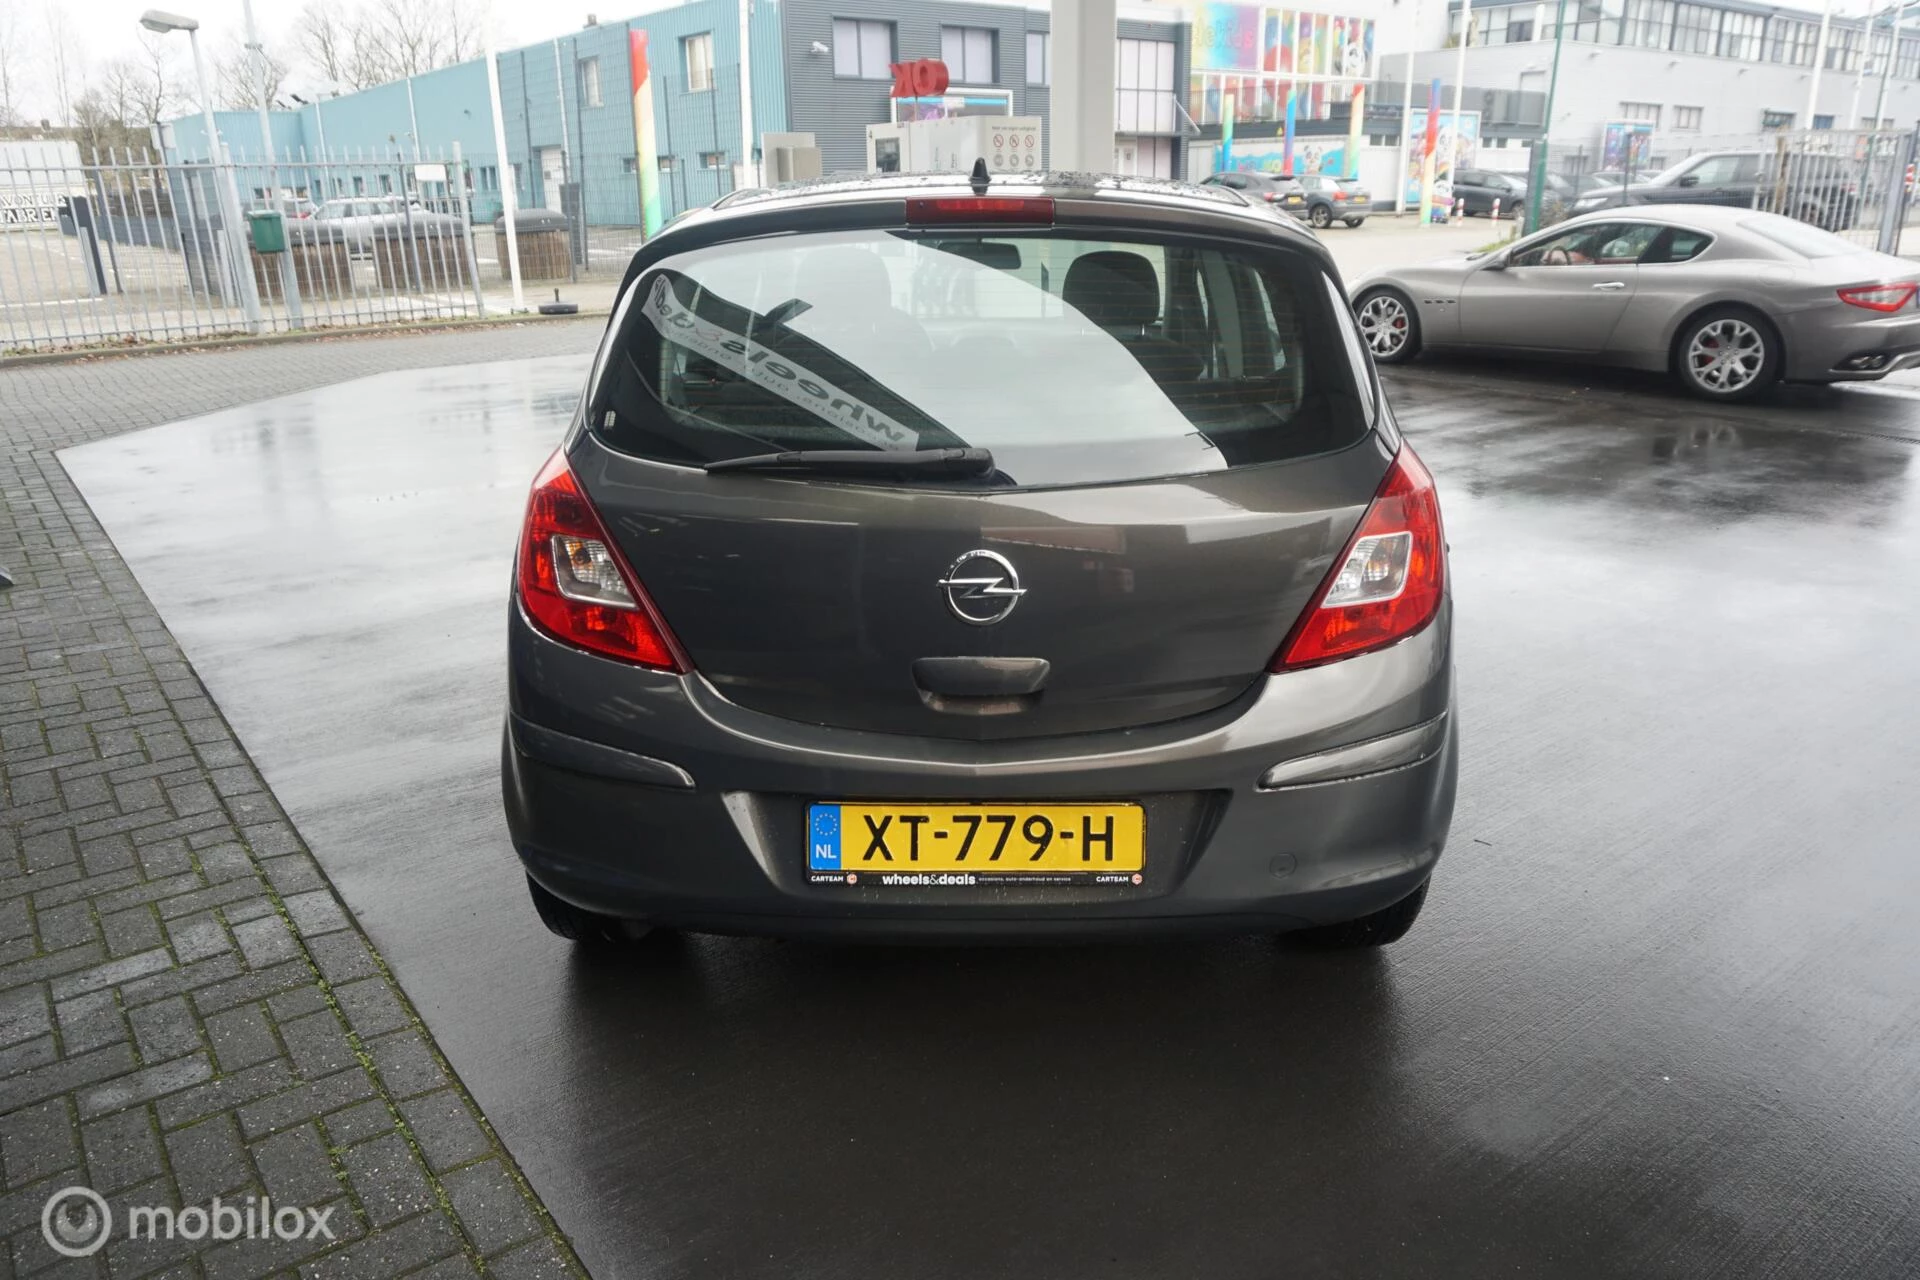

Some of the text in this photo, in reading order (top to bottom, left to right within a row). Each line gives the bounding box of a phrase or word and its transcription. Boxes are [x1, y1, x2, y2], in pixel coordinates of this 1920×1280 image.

[862, 814, 1114, 861] XT-779-H
[815, 844, 837, 858] NL
[882, 874, 976, 885] wheels&deals
